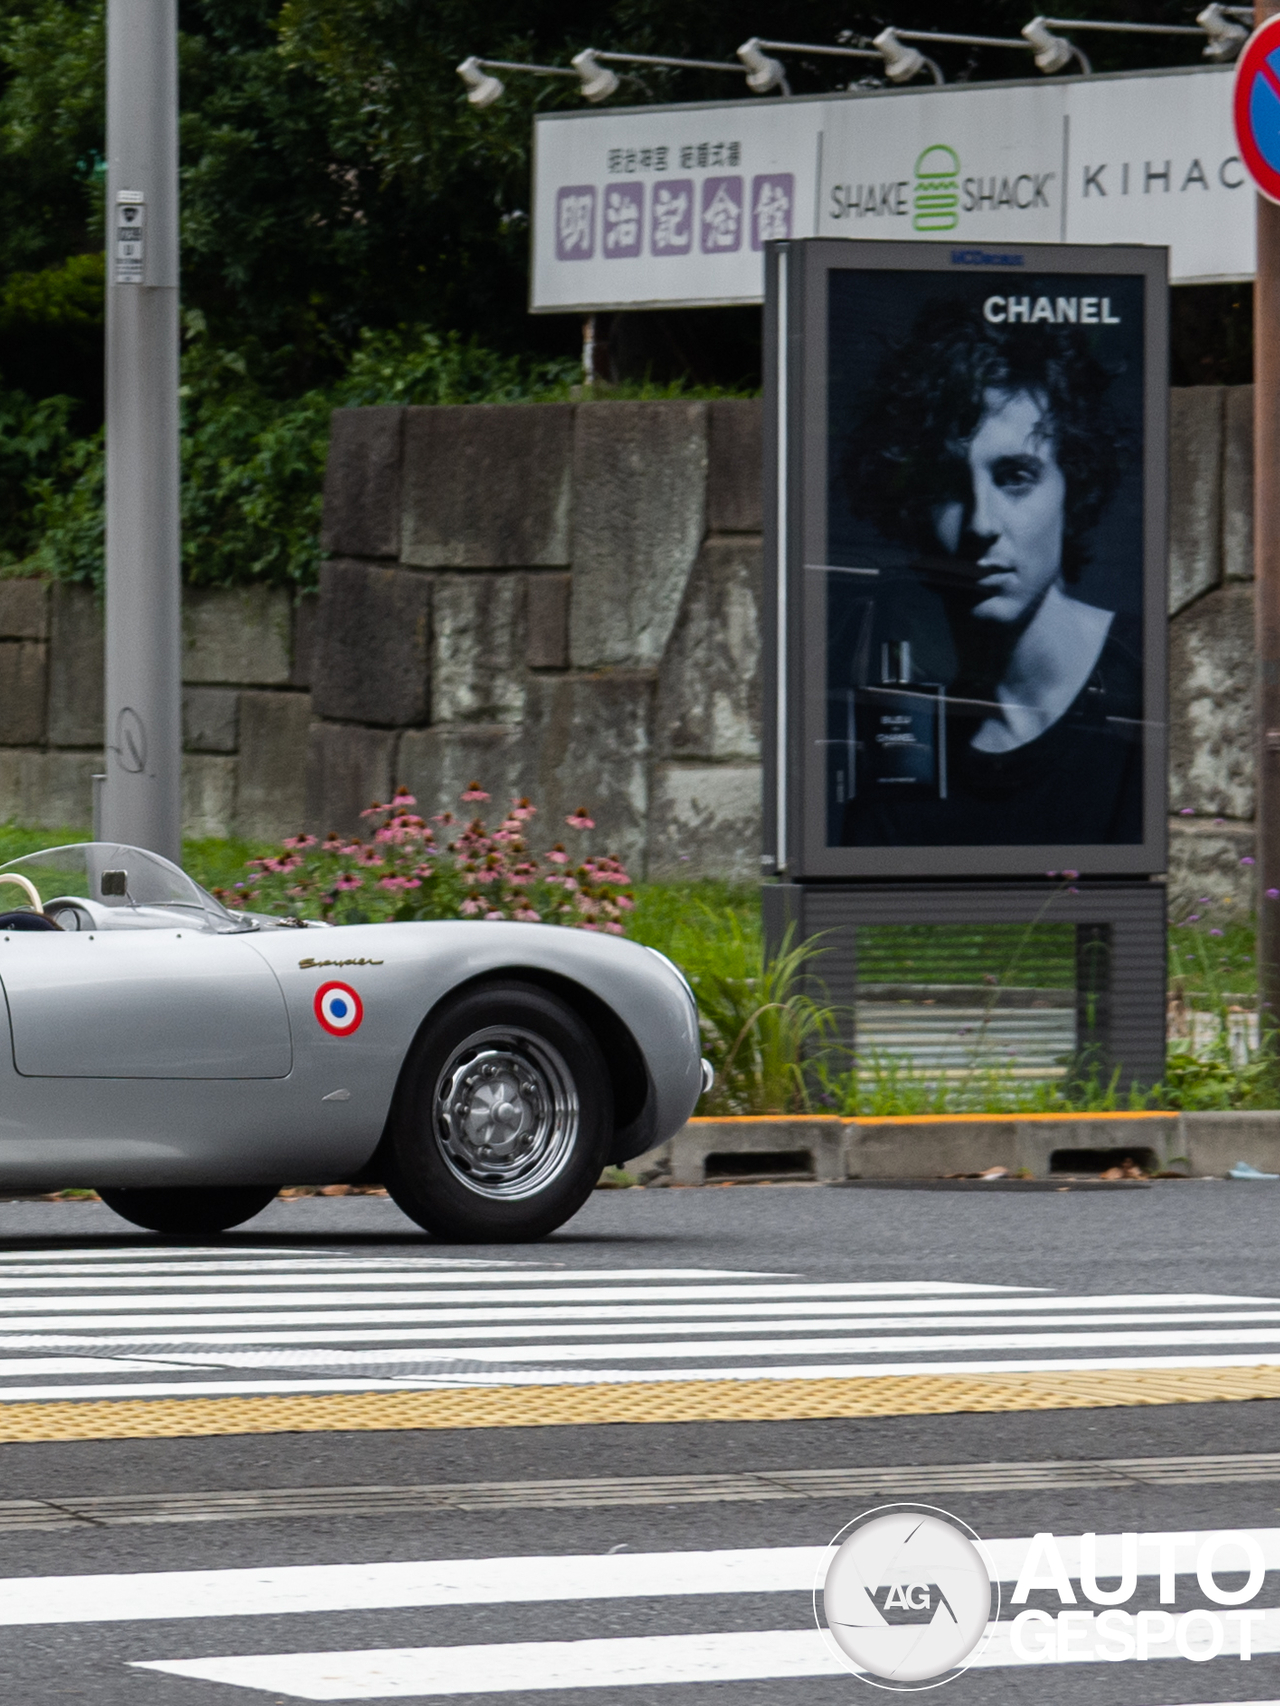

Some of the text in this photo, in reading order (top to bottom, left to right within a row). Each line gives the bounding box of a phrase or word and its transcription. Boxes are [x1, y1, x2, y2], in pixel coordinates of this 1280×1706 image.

[830, 173, 1050, 220] SHAKE SHACK
[983, 295, 1121, 324] CHANEL
